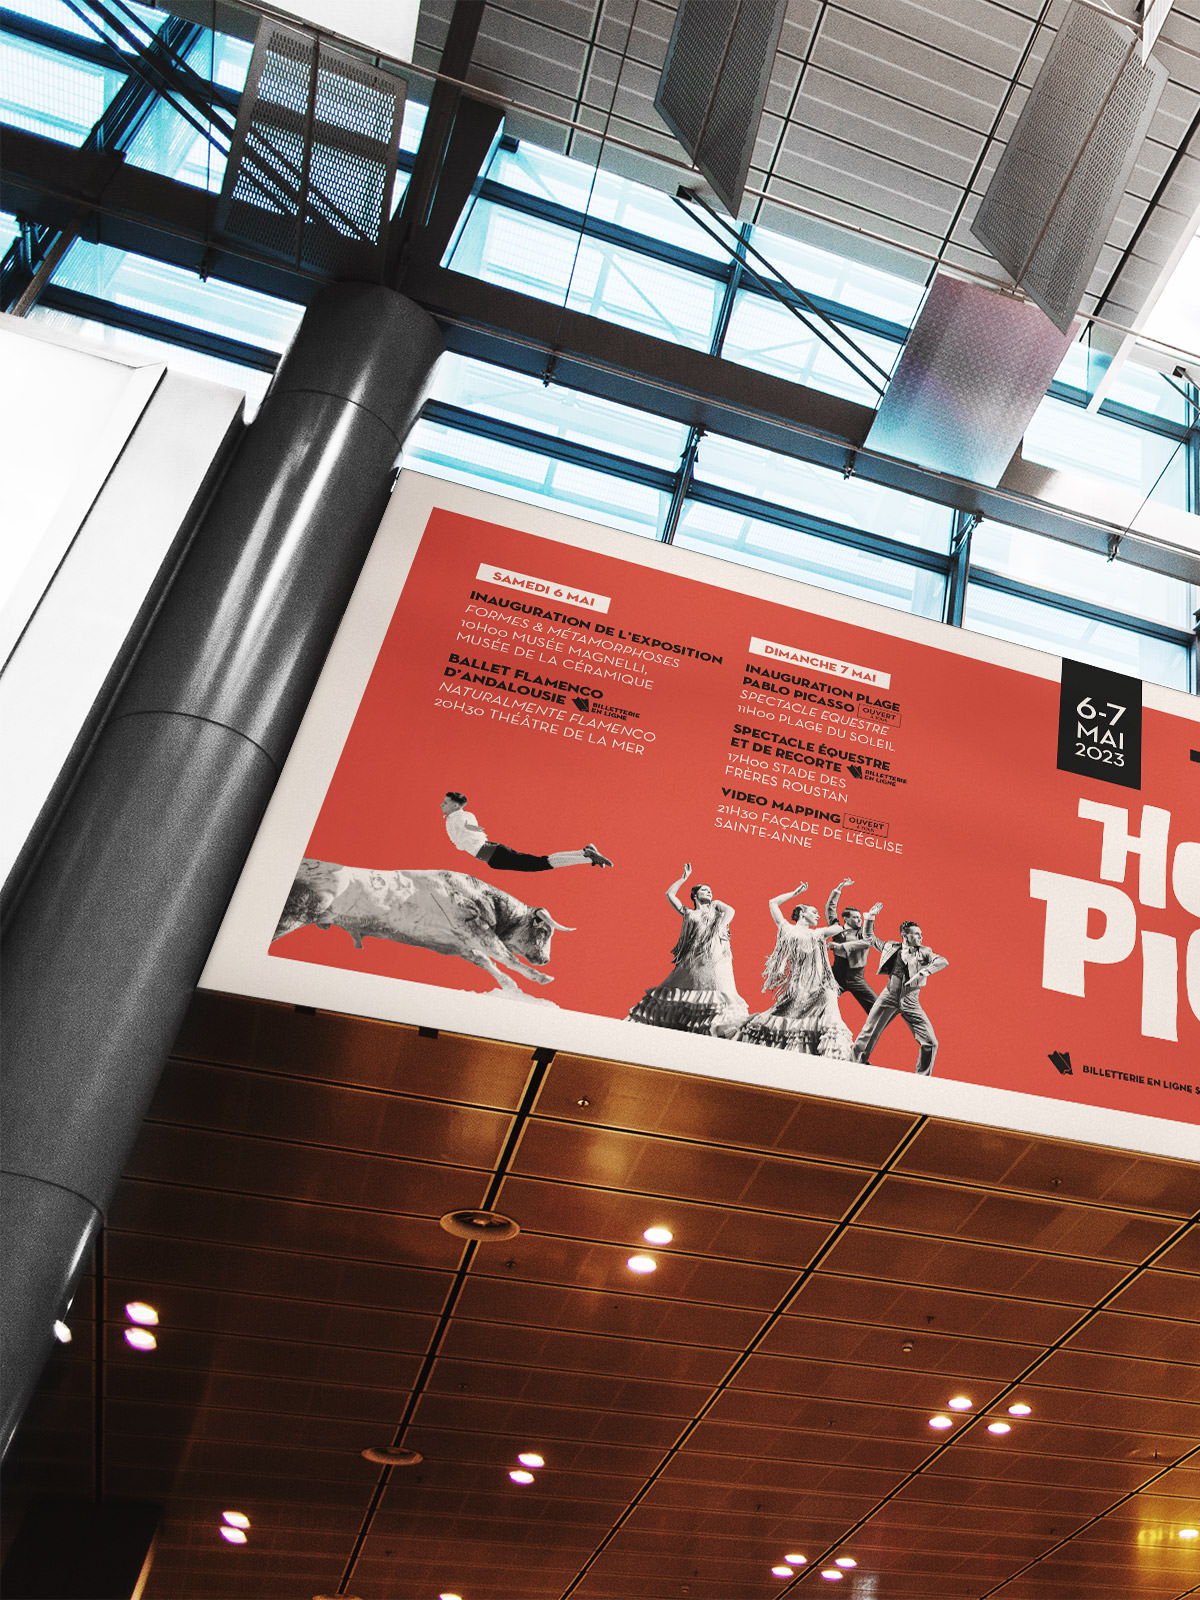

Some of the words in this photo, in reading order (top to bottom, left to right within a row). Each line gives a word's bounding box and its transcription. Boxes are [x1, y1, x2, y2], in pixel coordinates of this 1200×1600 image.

[492, 571, 550, 595] SAMEDI
[554, 588, 562, 598] 6
[566, 591, 594, 607] MAI
[470, 591, 591, 629] INAUGURATION
[594, 623, 614, 636] DE
[461, 620, 508, 638] 10H00
[512, 630, 563, 652] MUSÉE
[568, 645, 648, 676] MAGNELLI,
[465, 604, 530, 628] FORMES
[532, 622, 543, 632] &
[547, 624, 680, 668] MÉTAMORPHOSES
[449, 653, 510, 676] BALLET
[514, 668, 604, 699] FLAMENCO
[456, 632, 509, 652] MUSÉE
[514, 646, 534, 660] DE
[538, 652, 557, 666] LA
[562, 656, 654, 690] CÉRAMIQUE
[765, 645, 836, 672] DIMANCHE
[841, 665, 849, 674] 7
[852, 668, 876, 682] MAI
[743, 677, 790, 695] PABLO
[794, 690, 855, 712] PICASSO
[746, 664, 853, 700] INAUGURATION
[856, 693, 900, 712] PLAGE
[434, 698, 485, 716] 20H30
[490, 708, 558, 734] THÉÂTRE
[563, 727, 582, 740] DE
[588, 733, 607, 746] LA
[612, 738, 644, 755] MER
[439, 682, 565, 722] NATURALMENTE
[569, 713, 656, 742] FLAMENCO
[592, 702, 640, 719] BILLETTERIE
[592, 708, 602, 716] EN
[603, 711, 627, 721] LIGNE
[737, 705, 775, 721] 11H00
[779, 714, 823, 733] PLAGE
[827, 726, 846, 738] DU
[850, 732, 895, 752] SOLEIL
[740, 690, 818, 718] SPECTACLE
[820, 710, 889, 735] EQUESTRE
[862, 708, 896, 720] OUVERT
[1077, 697, 1126, 726] 6-7
[733, 724, 815, 751] SPECTACLE
[818, 744, 890, 771] ÉQUESTRE
[1077, 721, 1123, 750] MAI
[728, 753, 769, 769] 17H00
[772, 762, 815, 781] STADE
[820, 775, 847, 788] DES
[730, 737, 749, 749] ET
[752, 743, 771, 755] DE
[776, 748, 842, 773] RECORTE
[1075, 742, 1124, 767] 2023
[725, 765, 778, 787] FRÈRES
[782, 779, 848, 804] ROUSTAN
[717, 805, 758, 820] 21H30
[762, 813, 819, 834] FAÇADE
[823, 827, 842, 840] DE
[722, 787, 768, 806] VIDEO
[771, 799, 841, 823] MAPPING
[714, 817, 812, 849] SAINTE-ANNE
[849, 817, 884, 830] OUVERT
[1083, 1065, 1144, 1084] BILLETTERIE
[1147, 1078, 1161, 1087] EN
[1164, 1081, 1192, 1094] LIGNE
